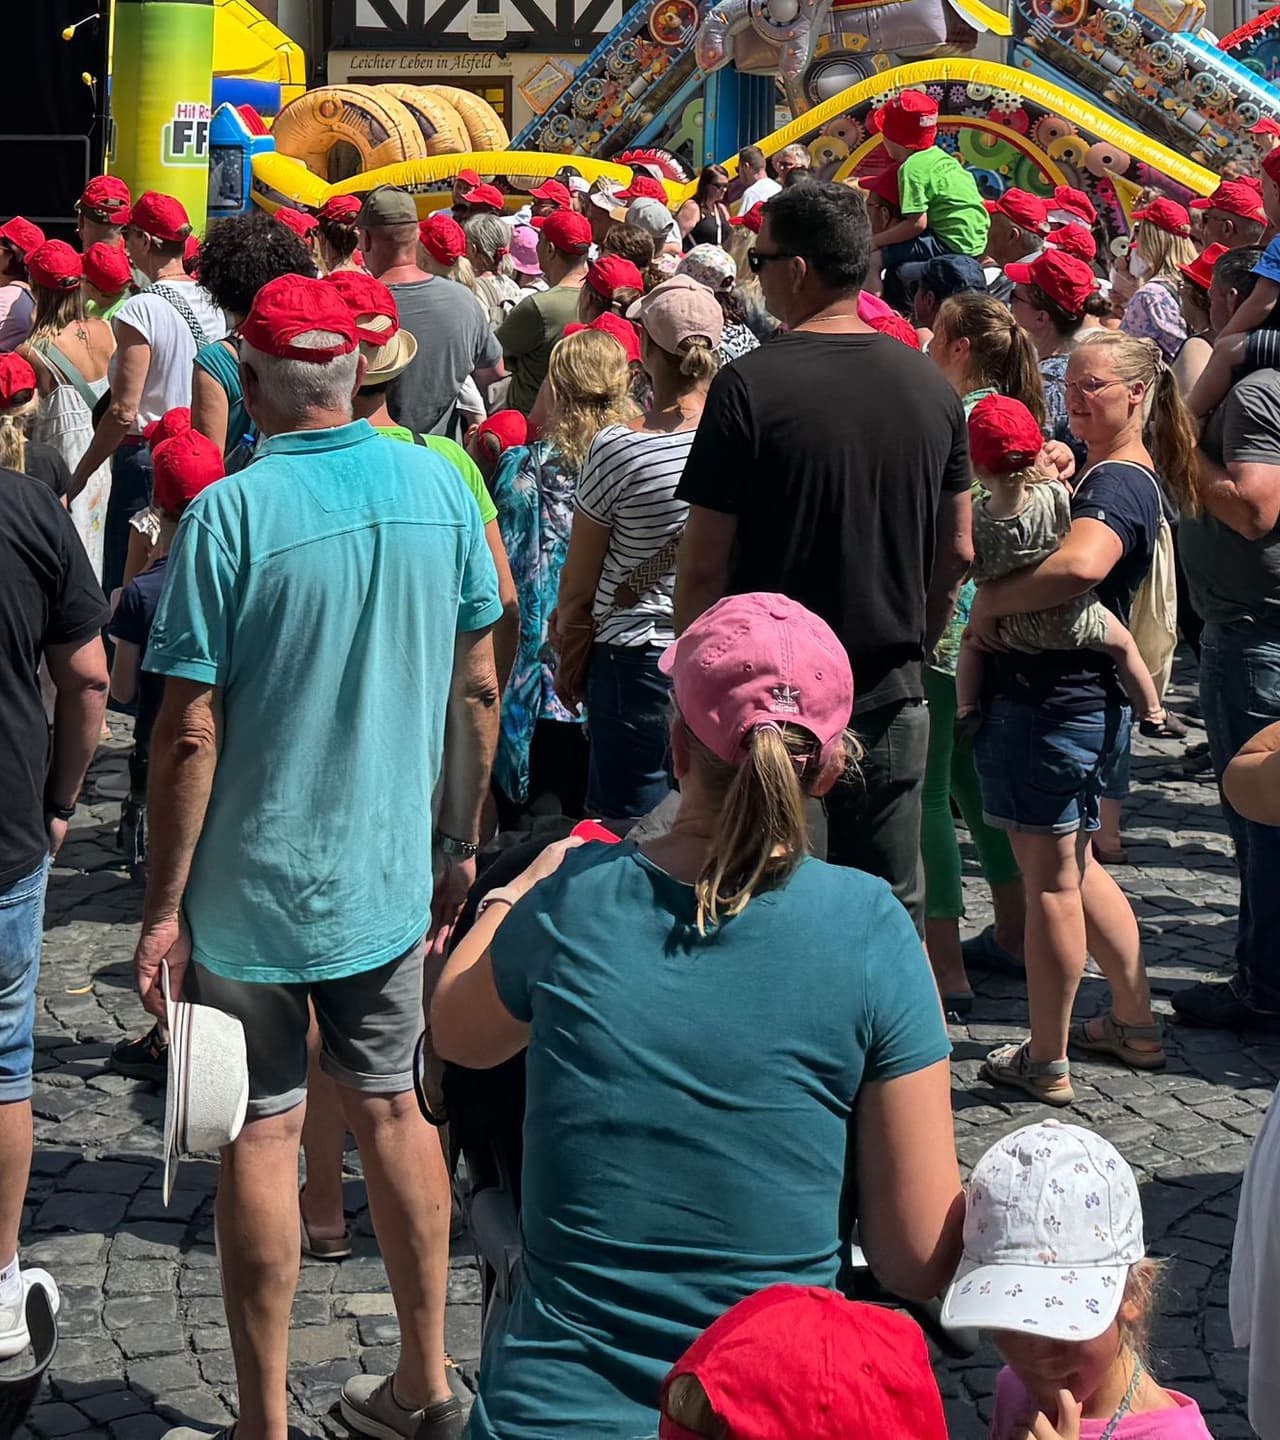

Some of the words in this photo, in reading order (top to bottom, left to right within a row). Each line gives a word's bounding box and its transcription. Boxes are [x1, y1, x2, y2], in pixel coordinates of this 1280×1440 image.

[350, 53, 395, 70] Leichter
[400, 53, 433, 70] Leben
[436, 55, 448, 69] in
[449, 52, 495, 73] Alsfeld
[177, 103, 196, 119] Hit
